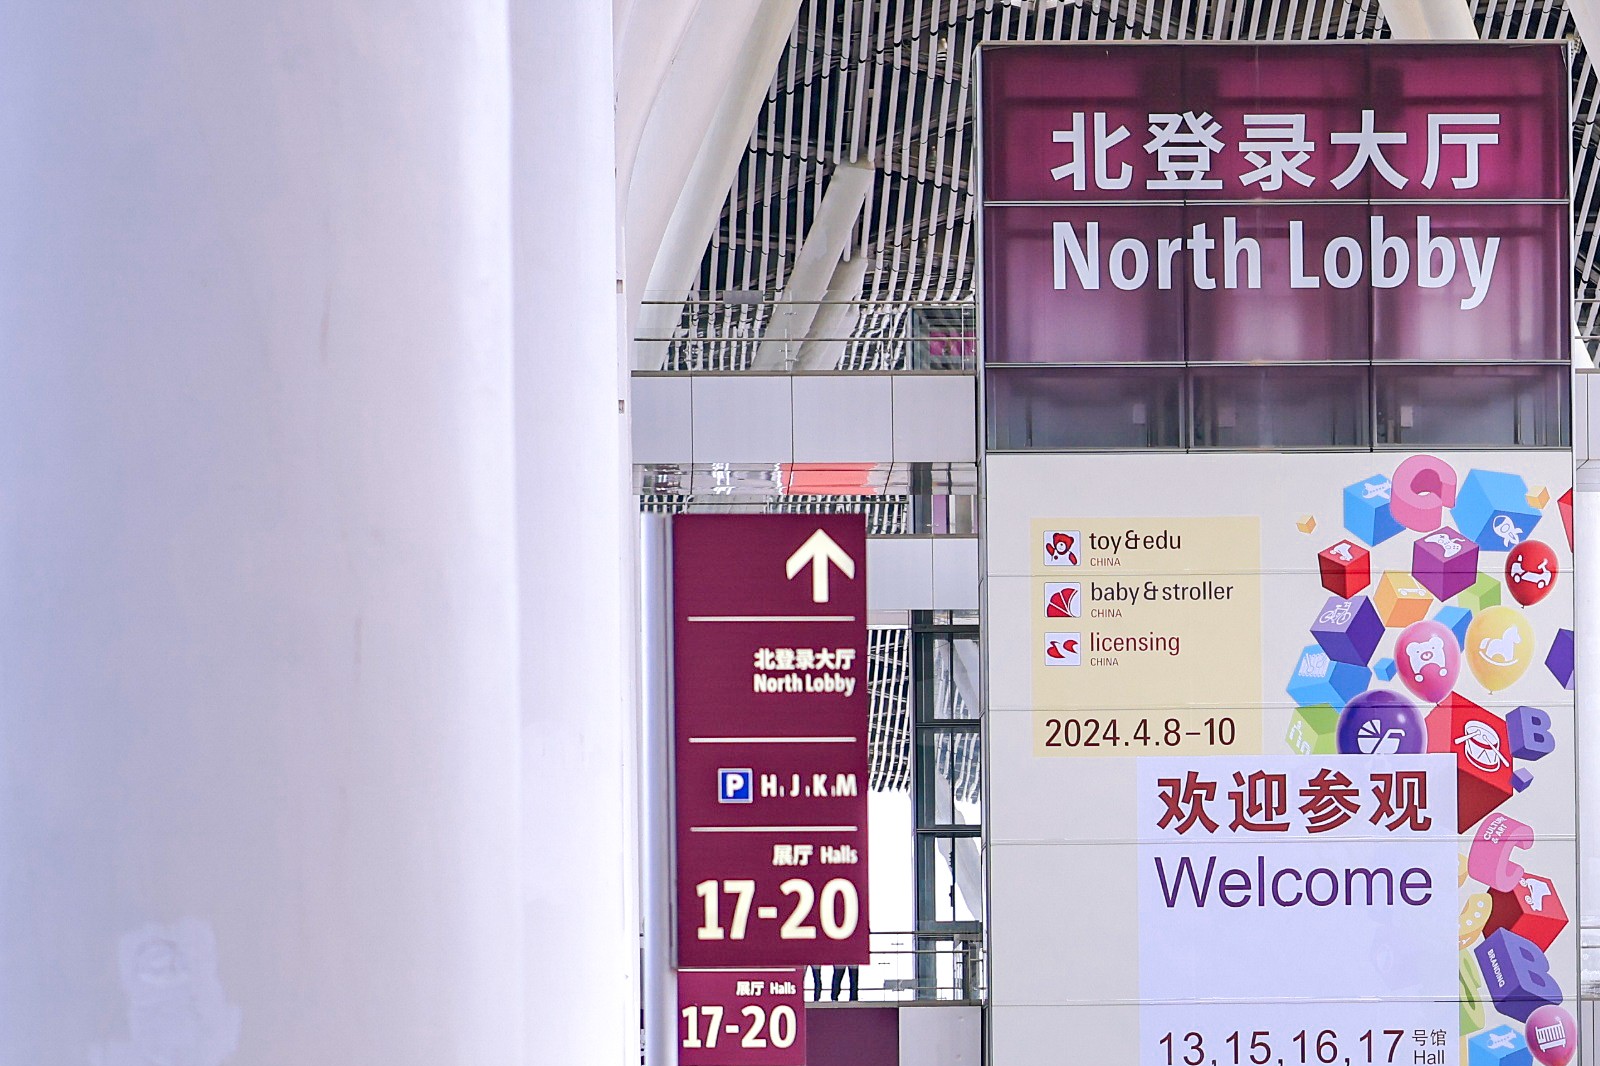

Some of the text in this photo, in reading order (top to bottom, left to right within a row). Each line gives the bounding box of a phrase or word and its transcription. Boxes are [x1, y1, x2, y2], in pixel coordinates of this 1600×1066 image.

[1050, 109, 1500, 191] 北登录大厅
[1052, 215, 1500, 310] North Lobby
[1090, 557, 1121, 567] CHINA
[1090, 608, 1123, 618] CHINA
[1090, 632, 1180, 656] licensing
[754, 648, 856, 671] 北登录大厅
[1090, 657, 1119, 667] CHINA
[753, 673, 856, 697] North Lobby
[1045, 717, 1236, 748] 2024.4.8-10
[1156, 768, 1432, 835] 欢迎参观
[773, 845, 858, 866] 展厅 Halls
[1154, 856, 1432, 908] Welcome
[696, 878, 859, 940] 17-20
[1486, 948, 1506, 989] BRANDING
[736, 981, 797, 997] 展厅 Halls
[681, 1005, 797, 1049] 17-20
[1412, 1028, 1447, 1047] 号馆
[1413, 1049, 1446, 1066] Hall
